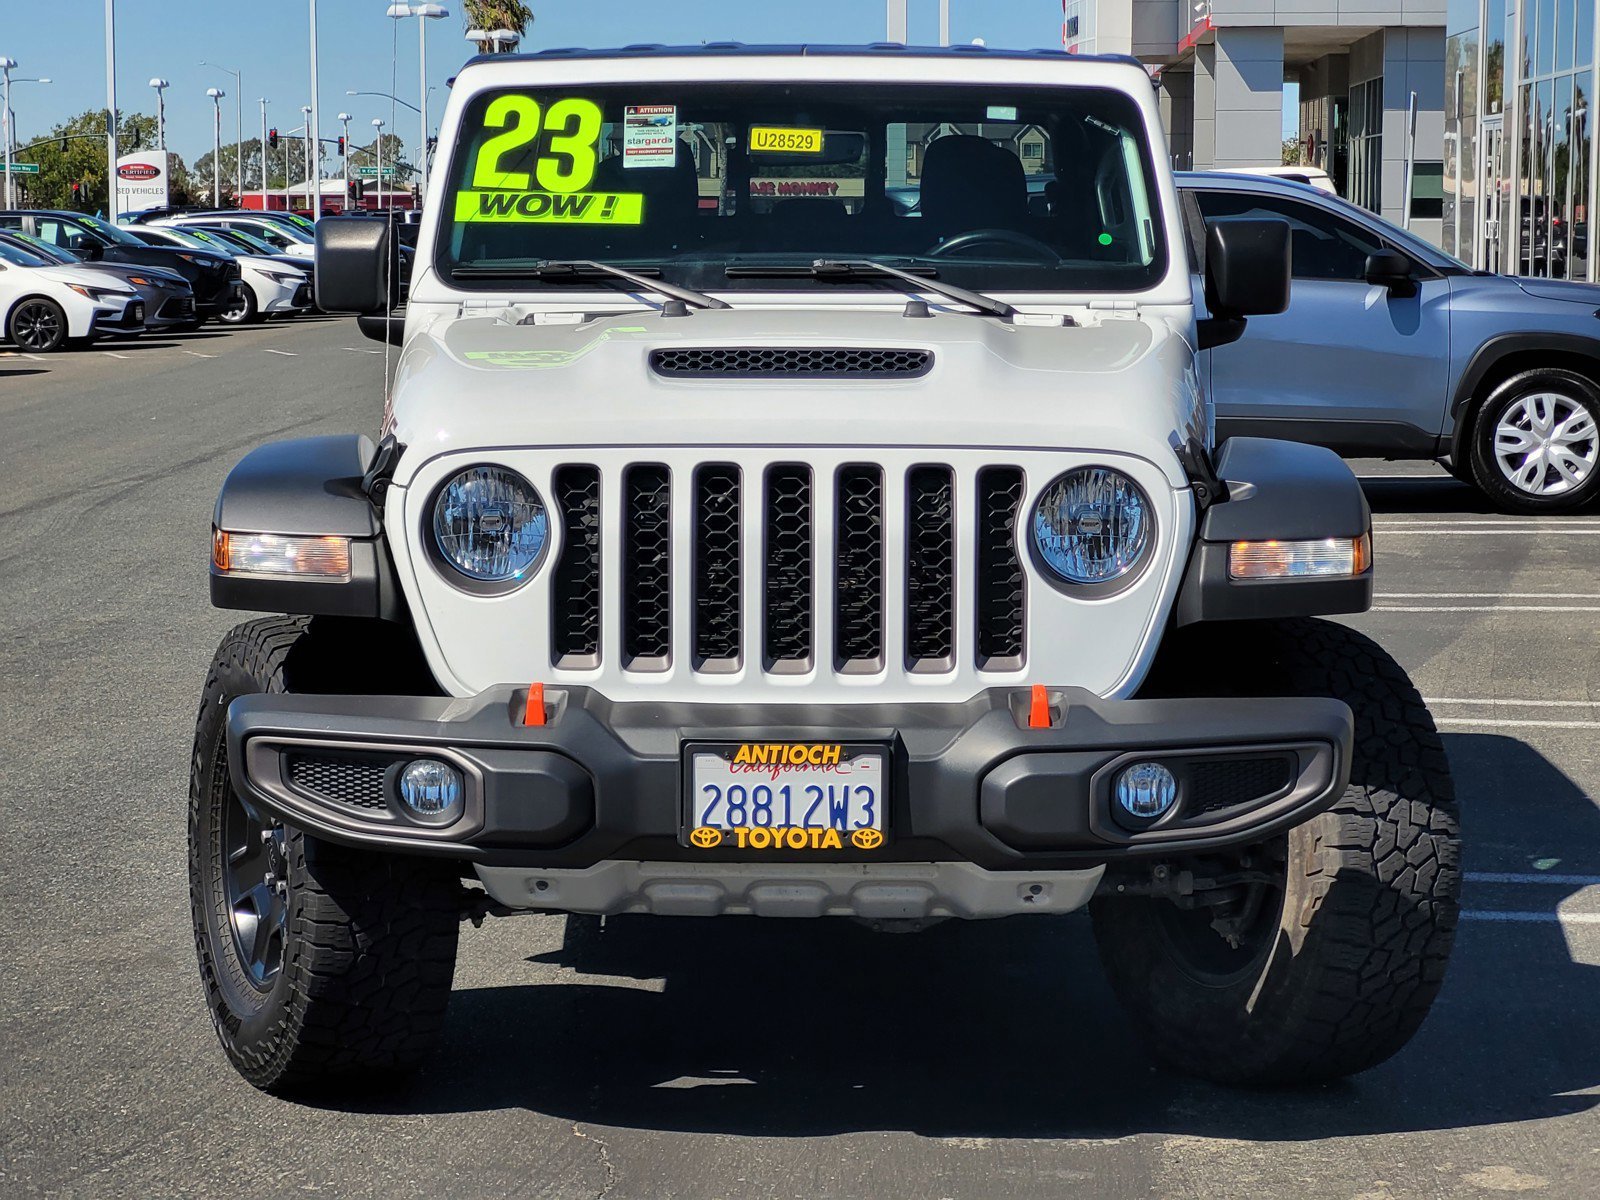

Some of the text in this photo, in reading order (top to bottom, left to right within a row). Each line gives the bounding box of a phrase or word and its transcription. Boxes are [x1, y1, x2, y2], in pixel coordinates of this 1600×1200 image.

[472, 95, 602, 193] 23
[757, 132, 814, 149] U28529
[479, 193, 597, 218] WOW
[733, 744, 841, 765] ANTIOCH
[700, 784, 875, 830] 28812W3
[734, 827, 842, 849] TOYOTA
